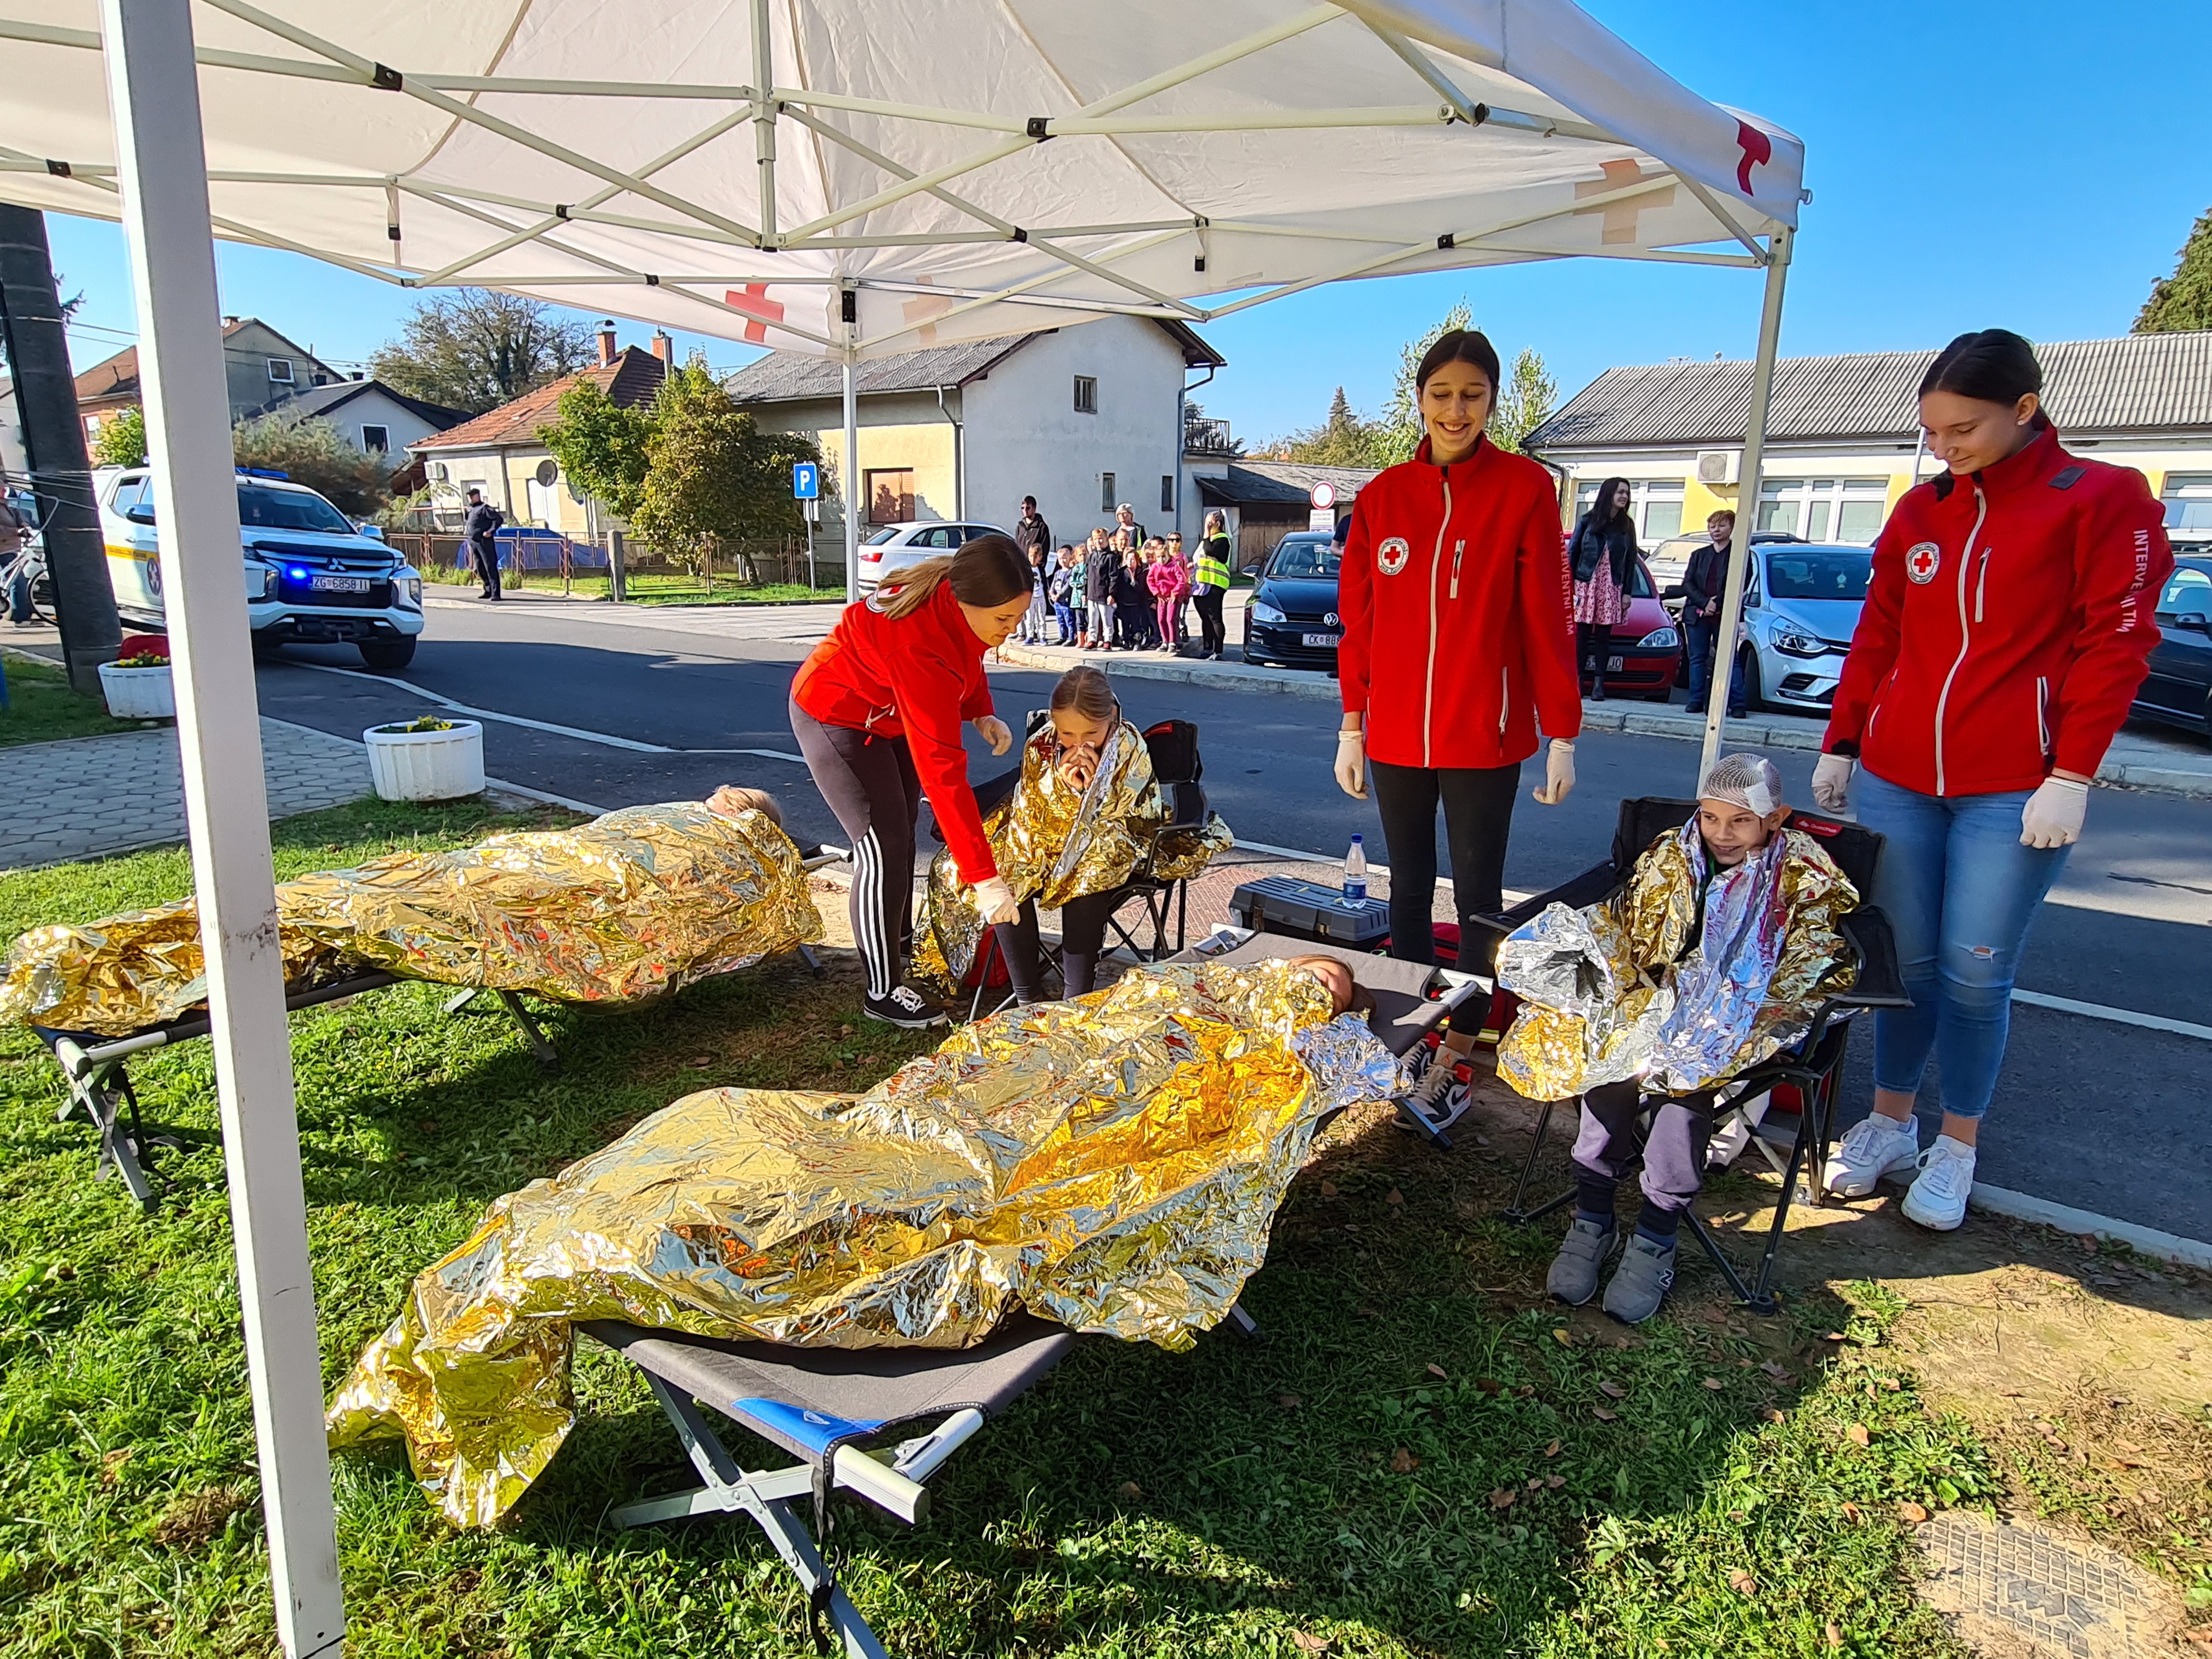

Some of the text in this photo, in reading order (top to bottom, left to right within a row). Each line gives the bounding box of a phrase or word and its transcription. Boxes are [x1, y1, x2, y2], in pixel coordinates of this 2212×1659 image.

[800, 470, 810, 491] P
[314, 577, 326, 588] ZG
[332, 578, 356, 589] 6858
[1566, 613, 1574, 635] TIM
